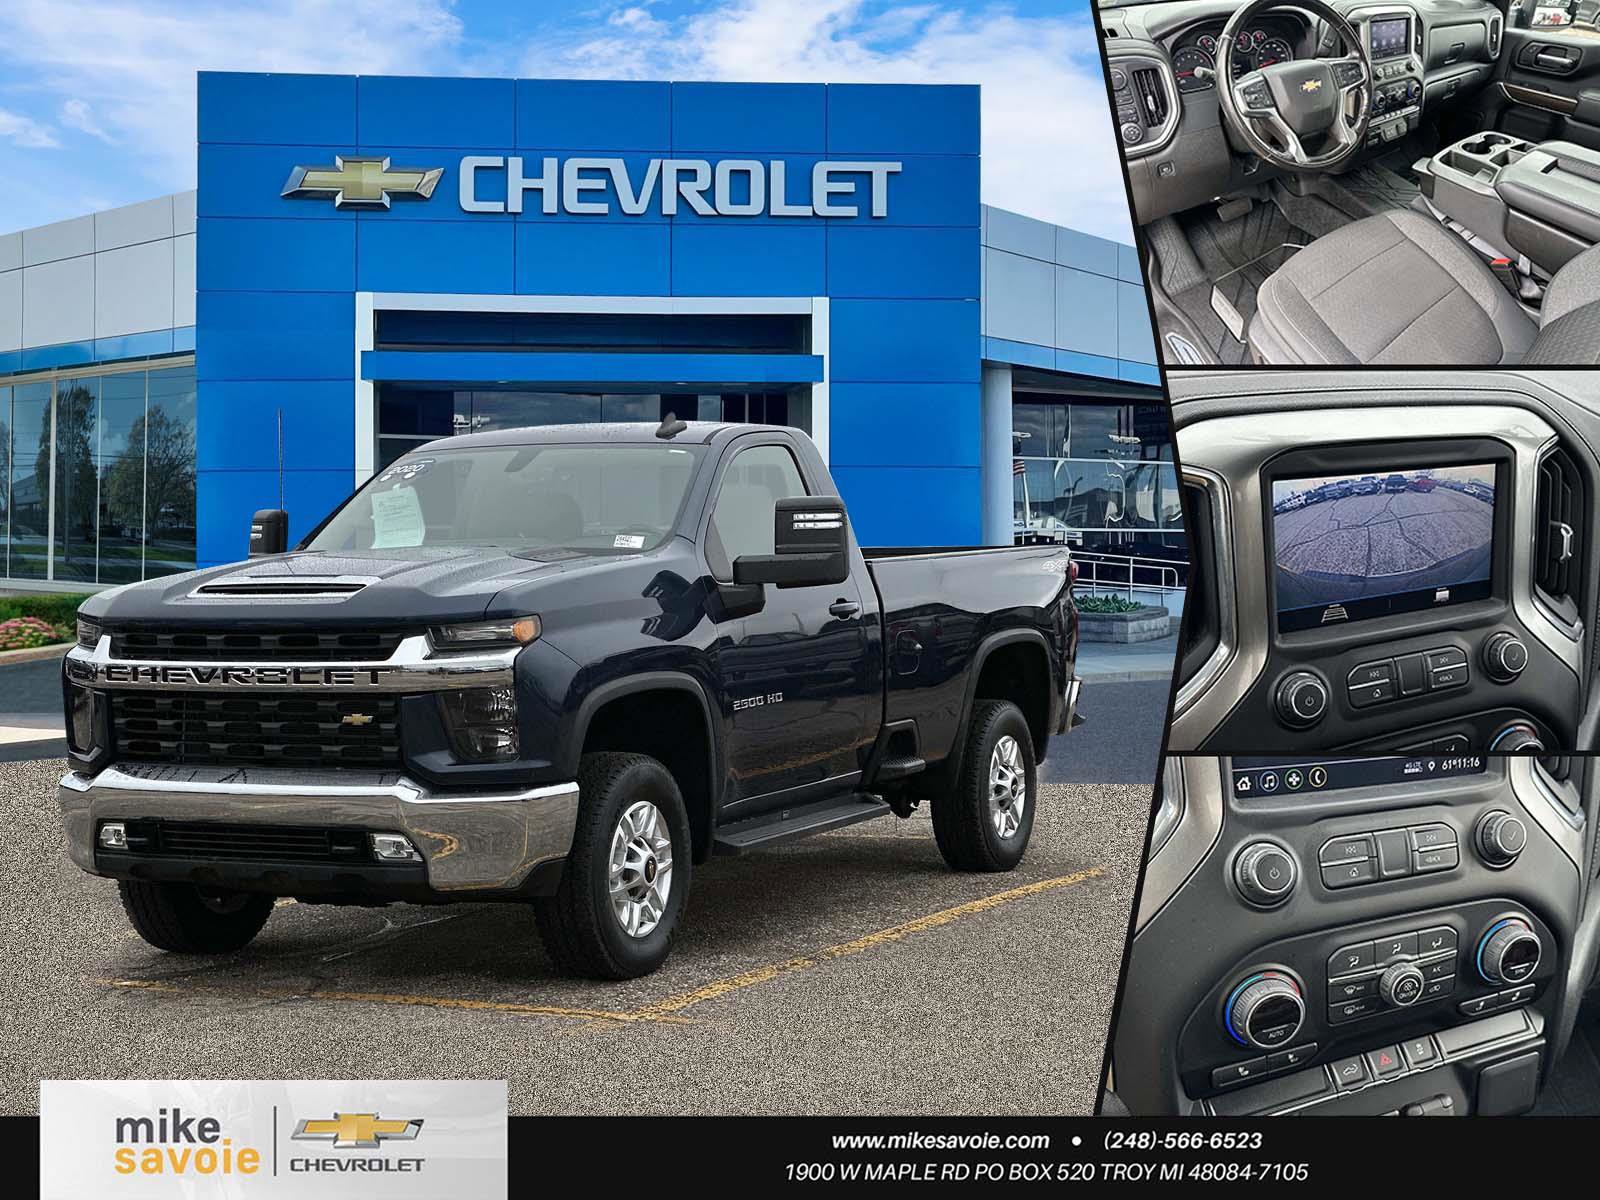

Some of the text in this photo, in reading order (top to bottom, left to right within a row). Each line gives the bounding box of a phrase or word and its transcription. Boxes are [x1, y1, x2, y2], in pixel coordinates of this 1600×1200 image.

[460, 155, 902, 217] CHEVROLET
[105, 664, 391, 686] CHEVROLET
[733, 692, 783, 711] 2500 HD
